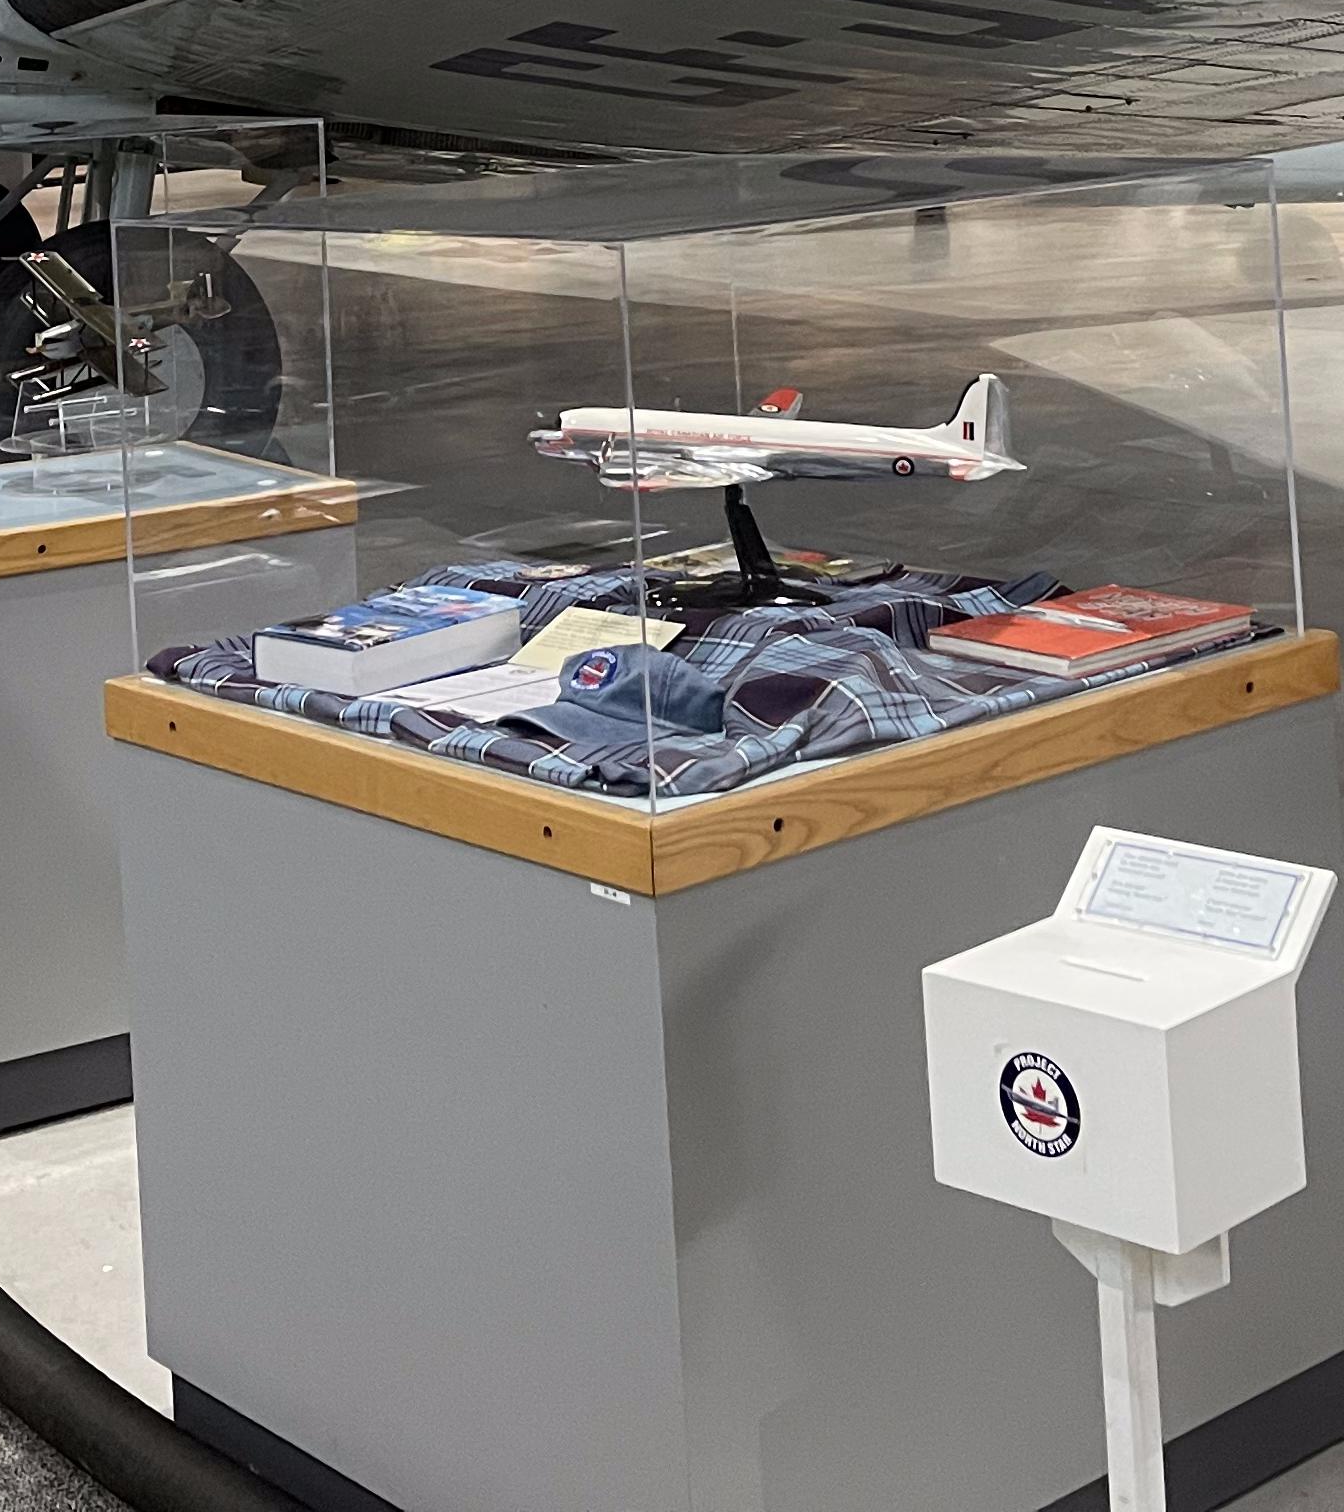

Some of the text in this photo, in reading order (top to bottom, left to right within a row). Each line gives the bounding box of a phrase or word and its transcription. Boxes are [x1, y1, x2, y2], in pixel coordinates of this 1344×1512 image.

[1014, 1055, 1062, 1080] PROJECT
[1011, 1120, 1072, 1155] NORTH STAR
